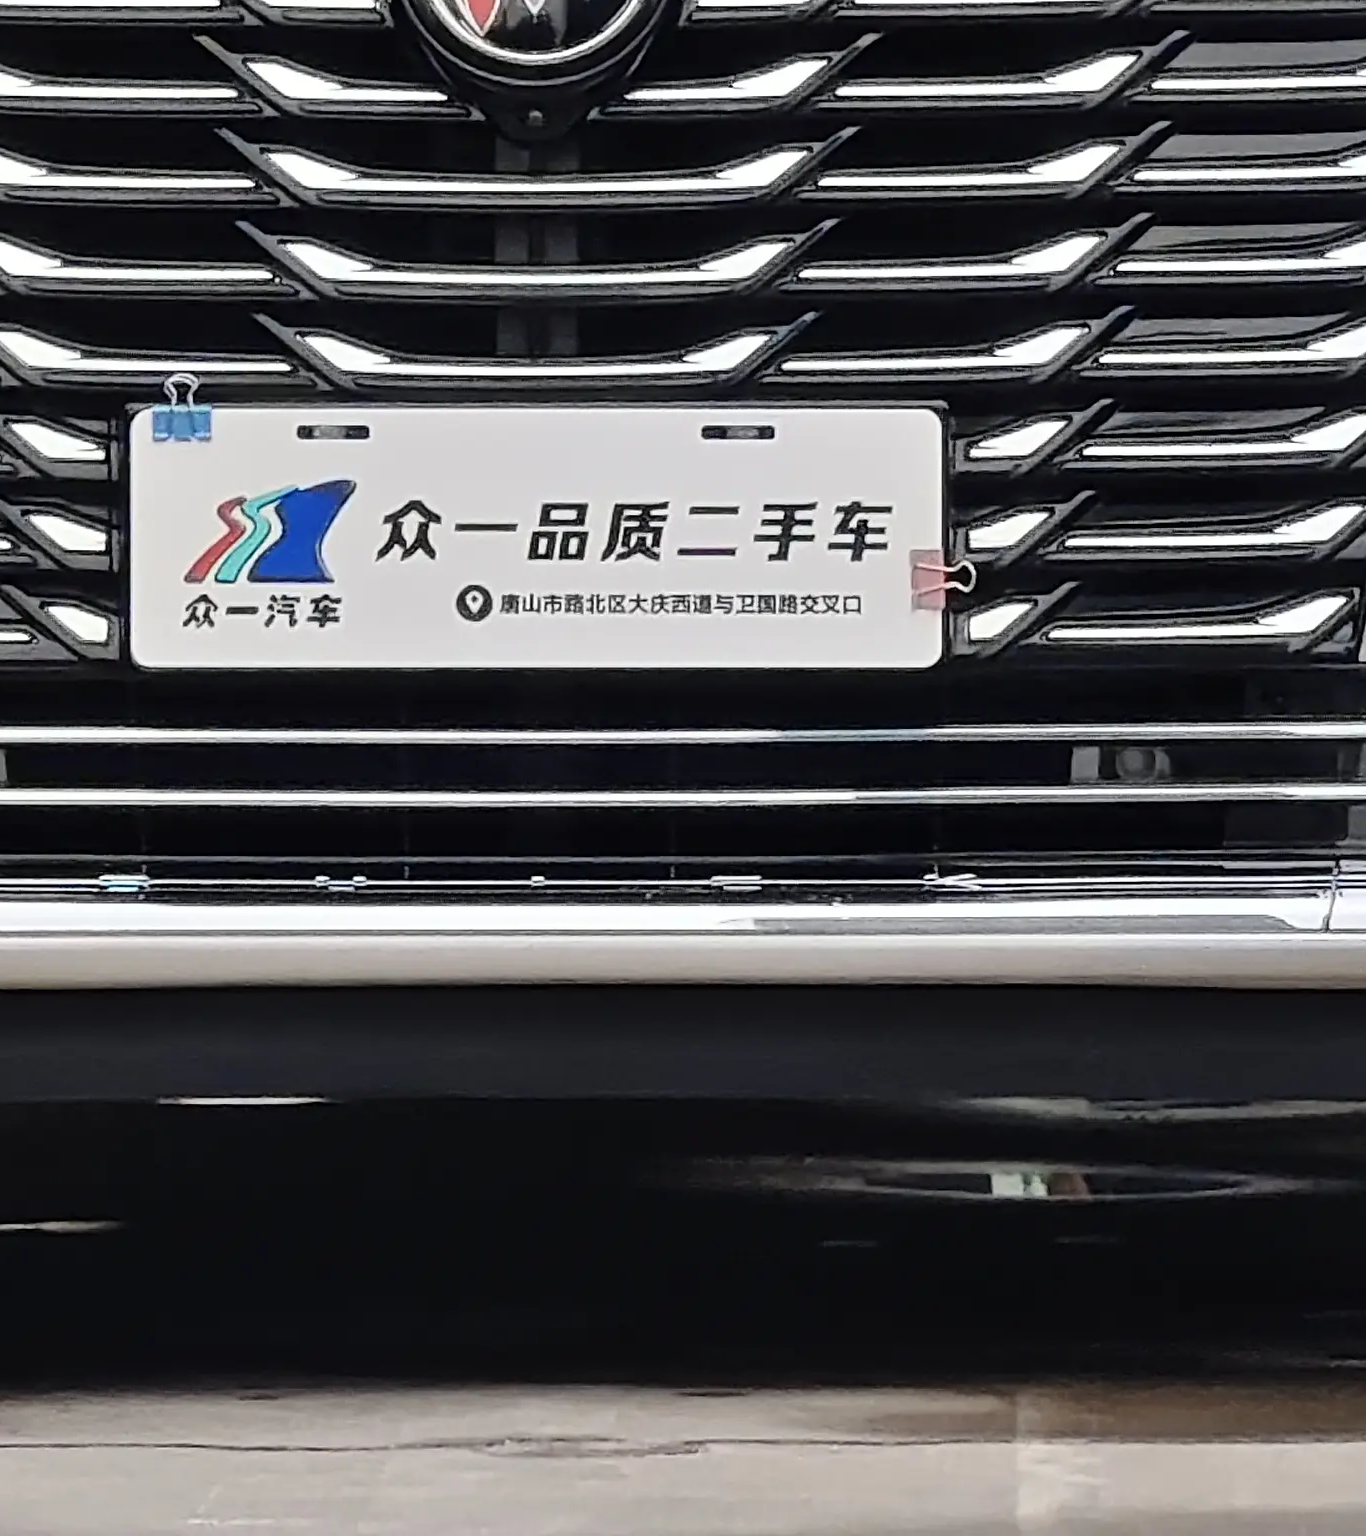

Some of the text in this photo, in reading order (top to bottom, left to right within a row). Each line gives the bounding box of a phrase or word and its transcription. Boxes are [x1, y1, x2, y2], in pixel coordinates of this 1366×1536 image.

[374, 498, 894, 563] 众一品质二手车
[182, 593, 343, 629] 众一汽车
